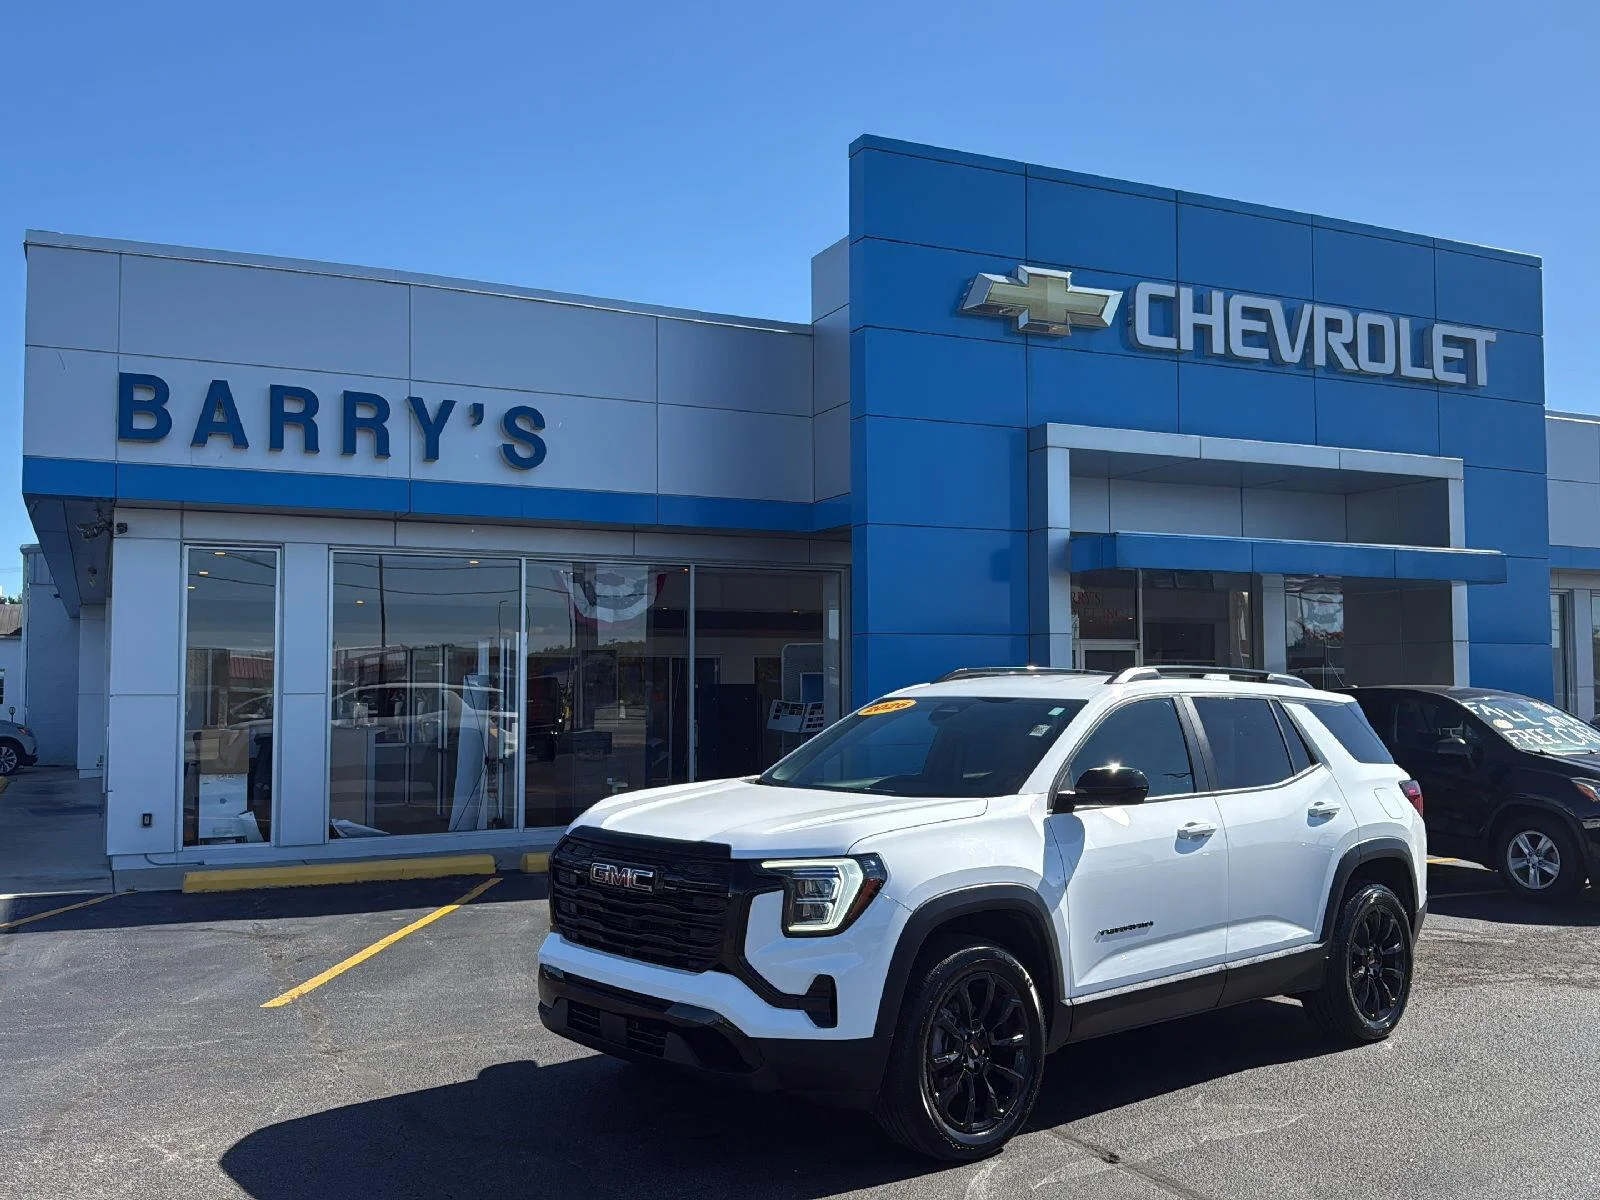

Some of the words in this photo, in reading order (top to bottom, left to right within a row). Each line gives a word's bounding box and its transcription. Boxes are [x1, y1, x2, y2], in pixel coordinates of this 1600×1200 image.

[1131, 280, 1498, 387] CHEVROLET
[116, 371, 548, 470] BARRY'S
[1502, 727, 1562, 746] FREE
[590, 862, 655, 893] GMC
